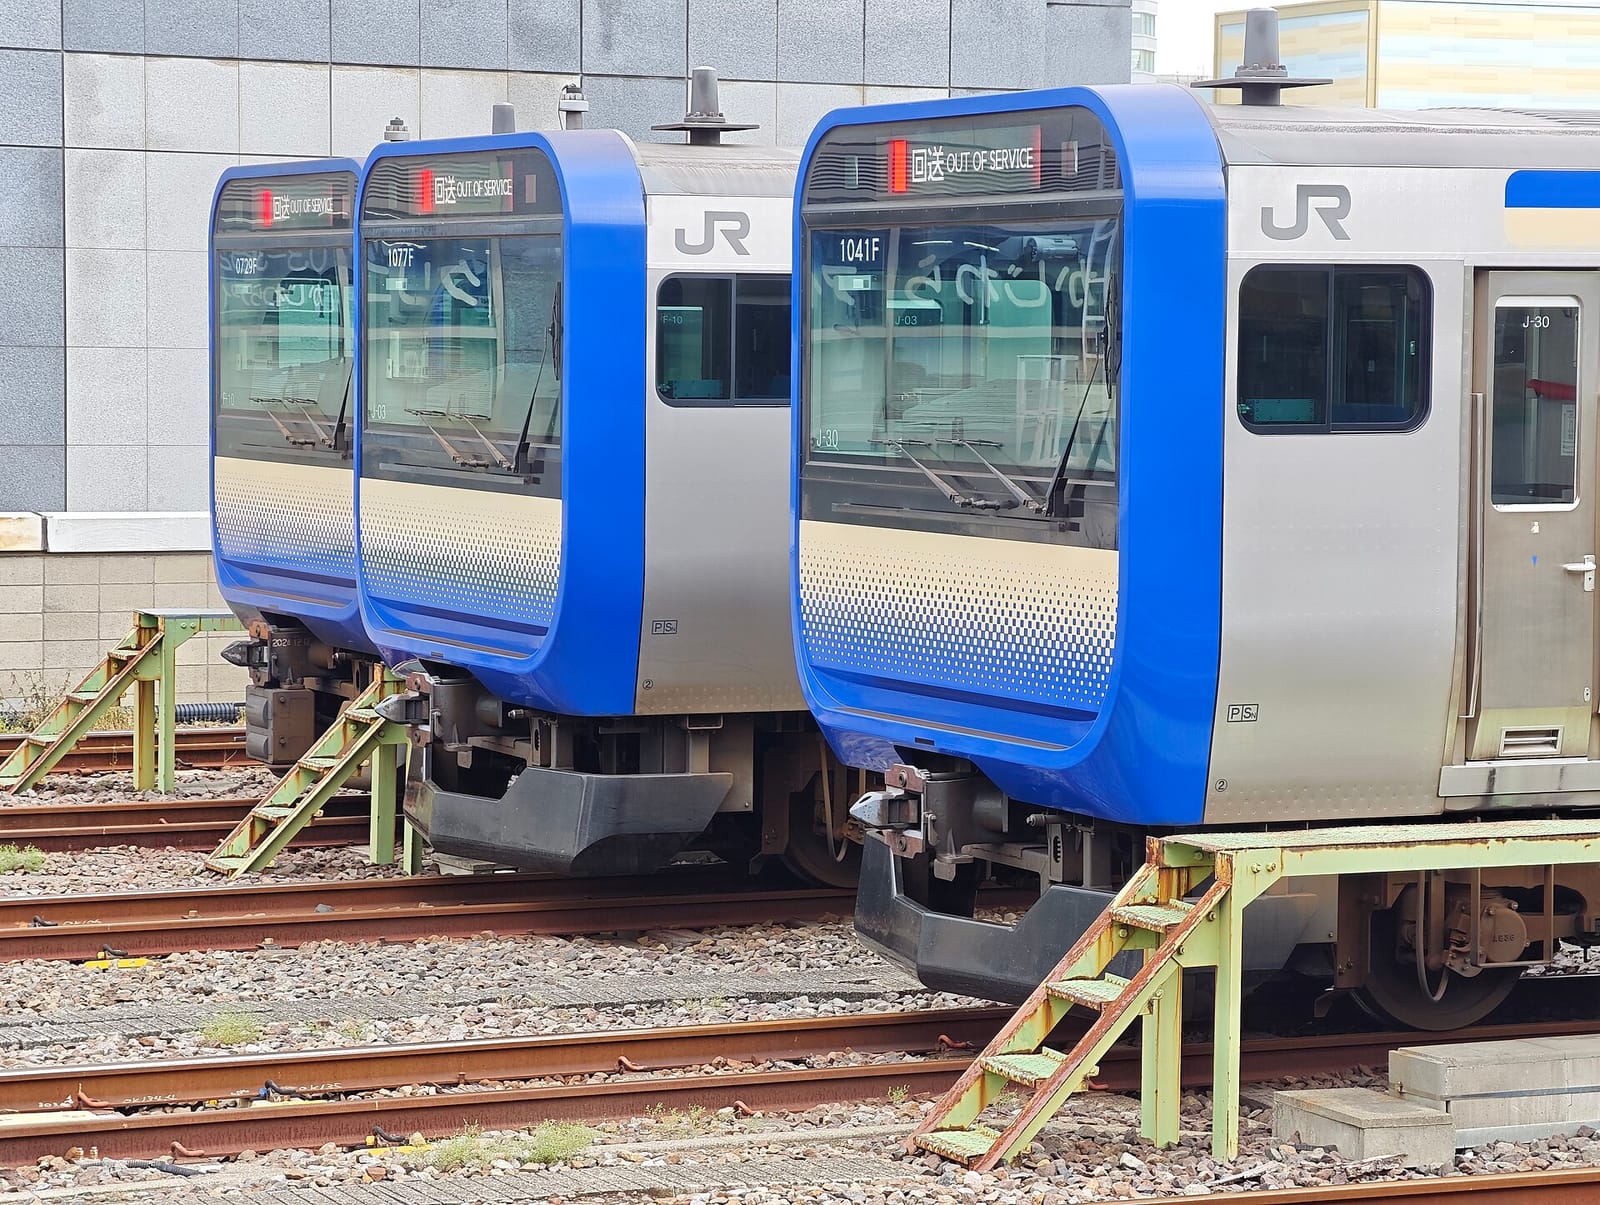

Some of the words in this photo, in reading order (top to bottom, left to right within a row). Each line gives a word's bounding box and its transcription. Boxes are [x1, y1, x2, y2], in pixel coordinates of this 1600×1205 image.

[911, 145, 945, 183] 回送
[946, 152, 971, 173] OUT
[972, 150, 988, 172] OF
[989, 147, 1034, 171] SERVICE
[434, 175, 457, 205] 回送
[457, 181, 473, 198] OUT
[473, 180, 484, 197] OF
[484, 178, 513, 197] SERVICE
[272, 194, 291, 220] 回送
[290, 199, 303, 215] OUT
[303, 198, 312, 214] OF
[312, 197, 334, 213] SERVICE
[1260, 184, 1352, 241] JR
[674, 210, 751, 256] JR
[387, 248, 414, 268] 1077F
[840, 237, 880, 262] 1041F
[235, 257, 258, 275] 0729F
[662, 315, 683, 325] F-10
[894, 315, 918, 326] J-03
[1521, 315, 1551, 328] J-30
[816, 429, 839, 447] J-30
